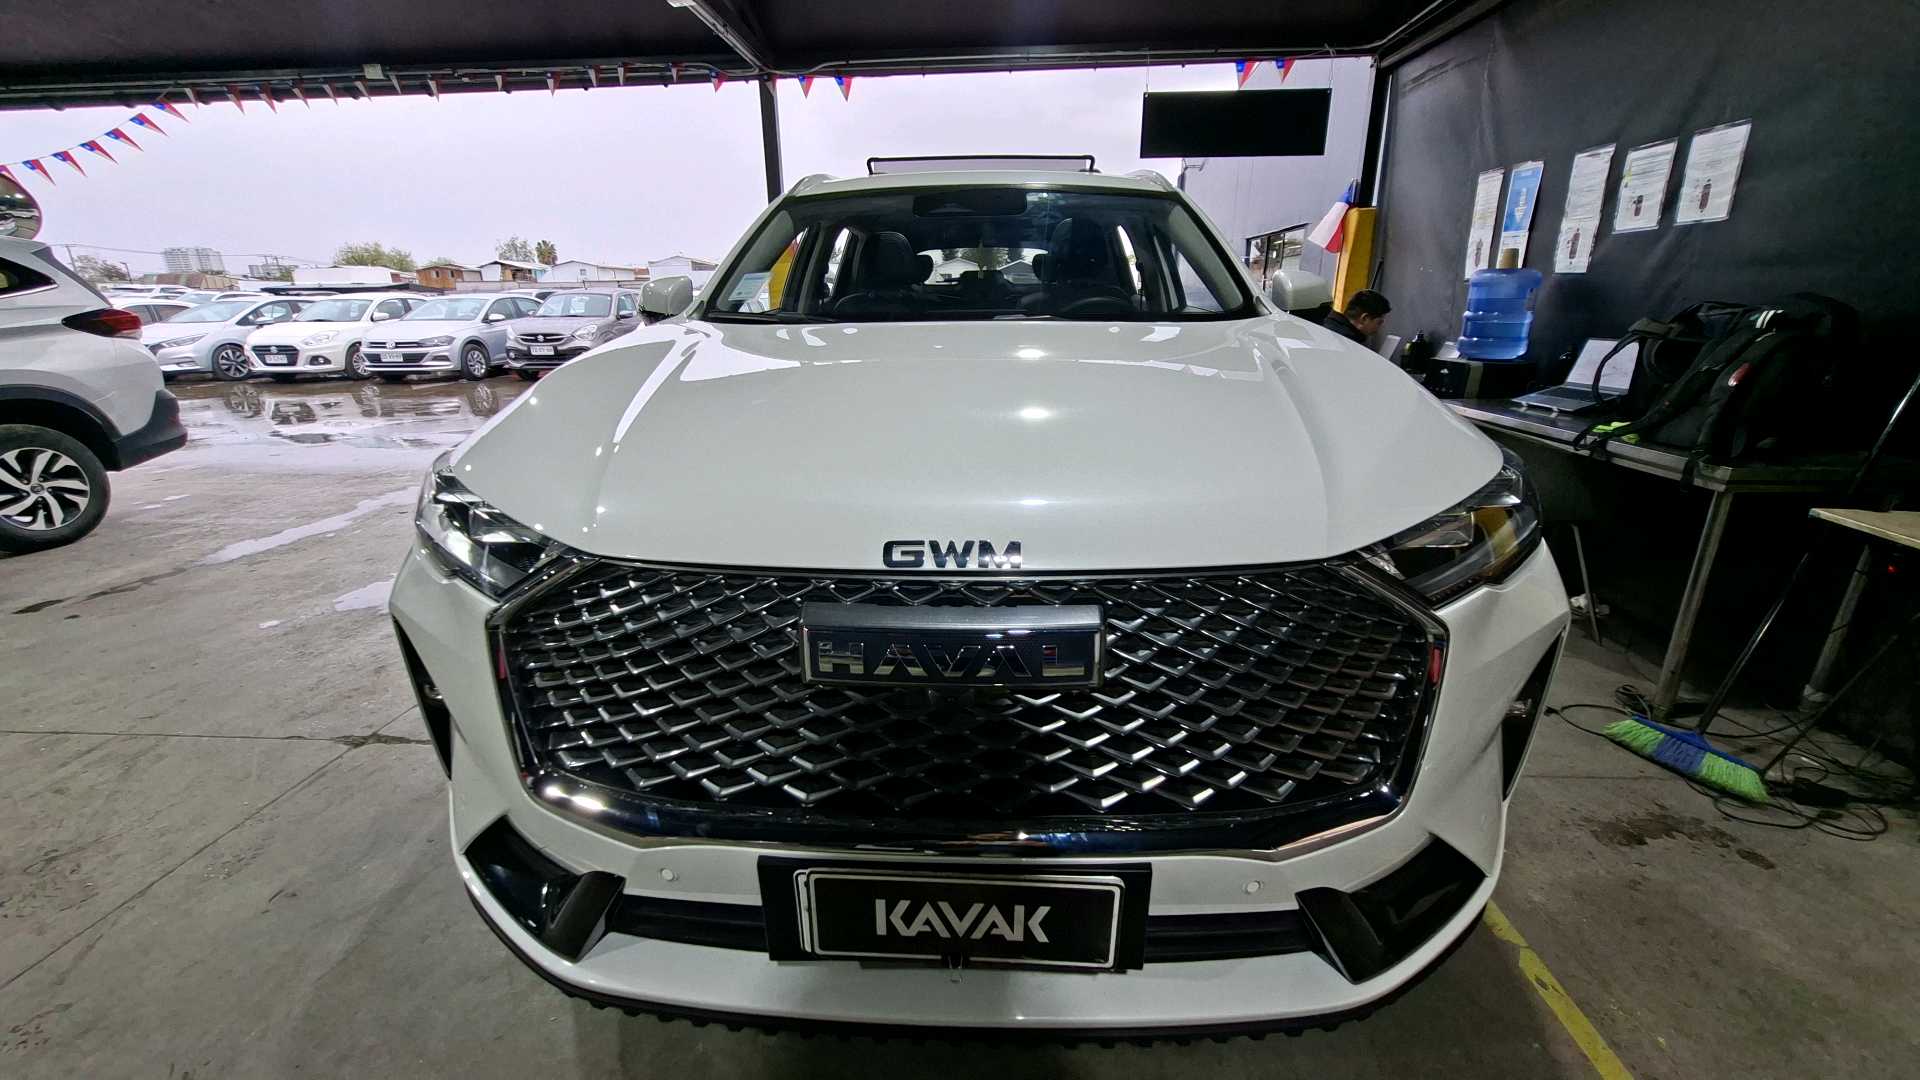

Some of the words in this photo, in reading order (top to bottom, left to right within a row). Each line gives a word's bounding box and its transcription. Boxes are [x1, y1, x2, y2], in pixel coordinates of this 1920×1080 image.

[883, 540, 1022, 568] GWM
[818, 640, 1085, 677] HAVAL
[875, 898, 1050, 943] KAVAK
